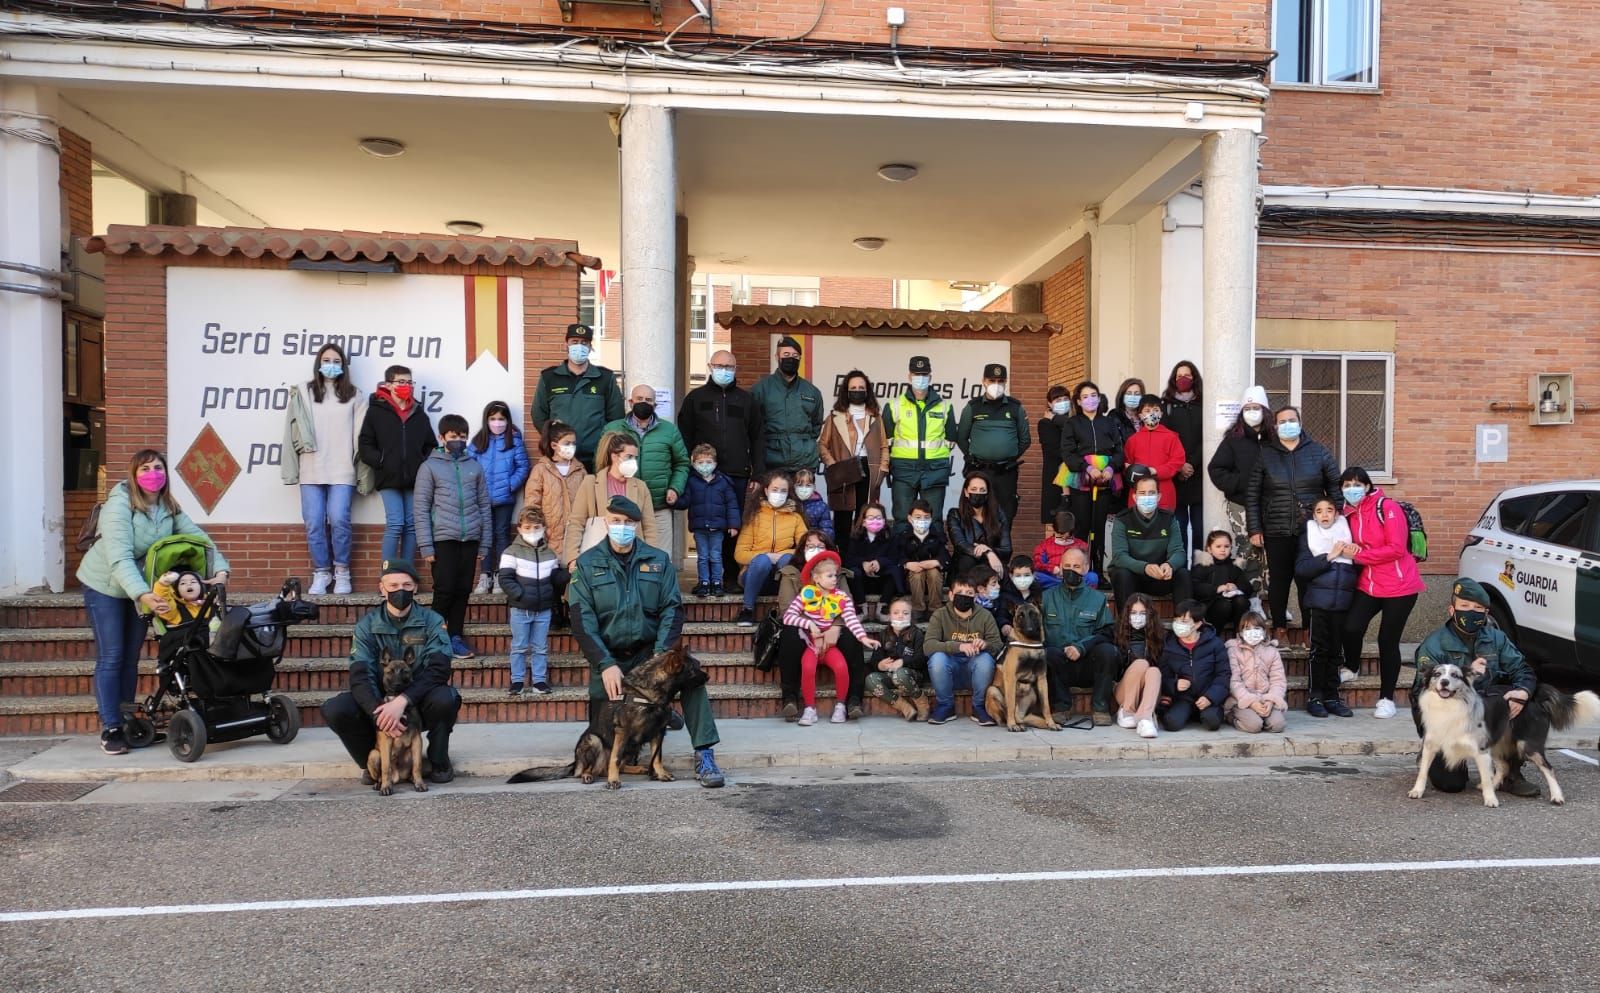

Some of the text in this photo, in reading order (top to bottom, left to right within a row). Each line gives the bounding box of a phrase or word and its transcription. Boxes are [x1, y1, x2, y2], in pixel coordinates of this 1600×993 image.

[201, 322, 442, 366] Será siempre un
[1482, 428, 1502, 455] P
[1516, 571, 1558, 592] GUARDIA
[1524, 590, 1548, 608] CIVIL
